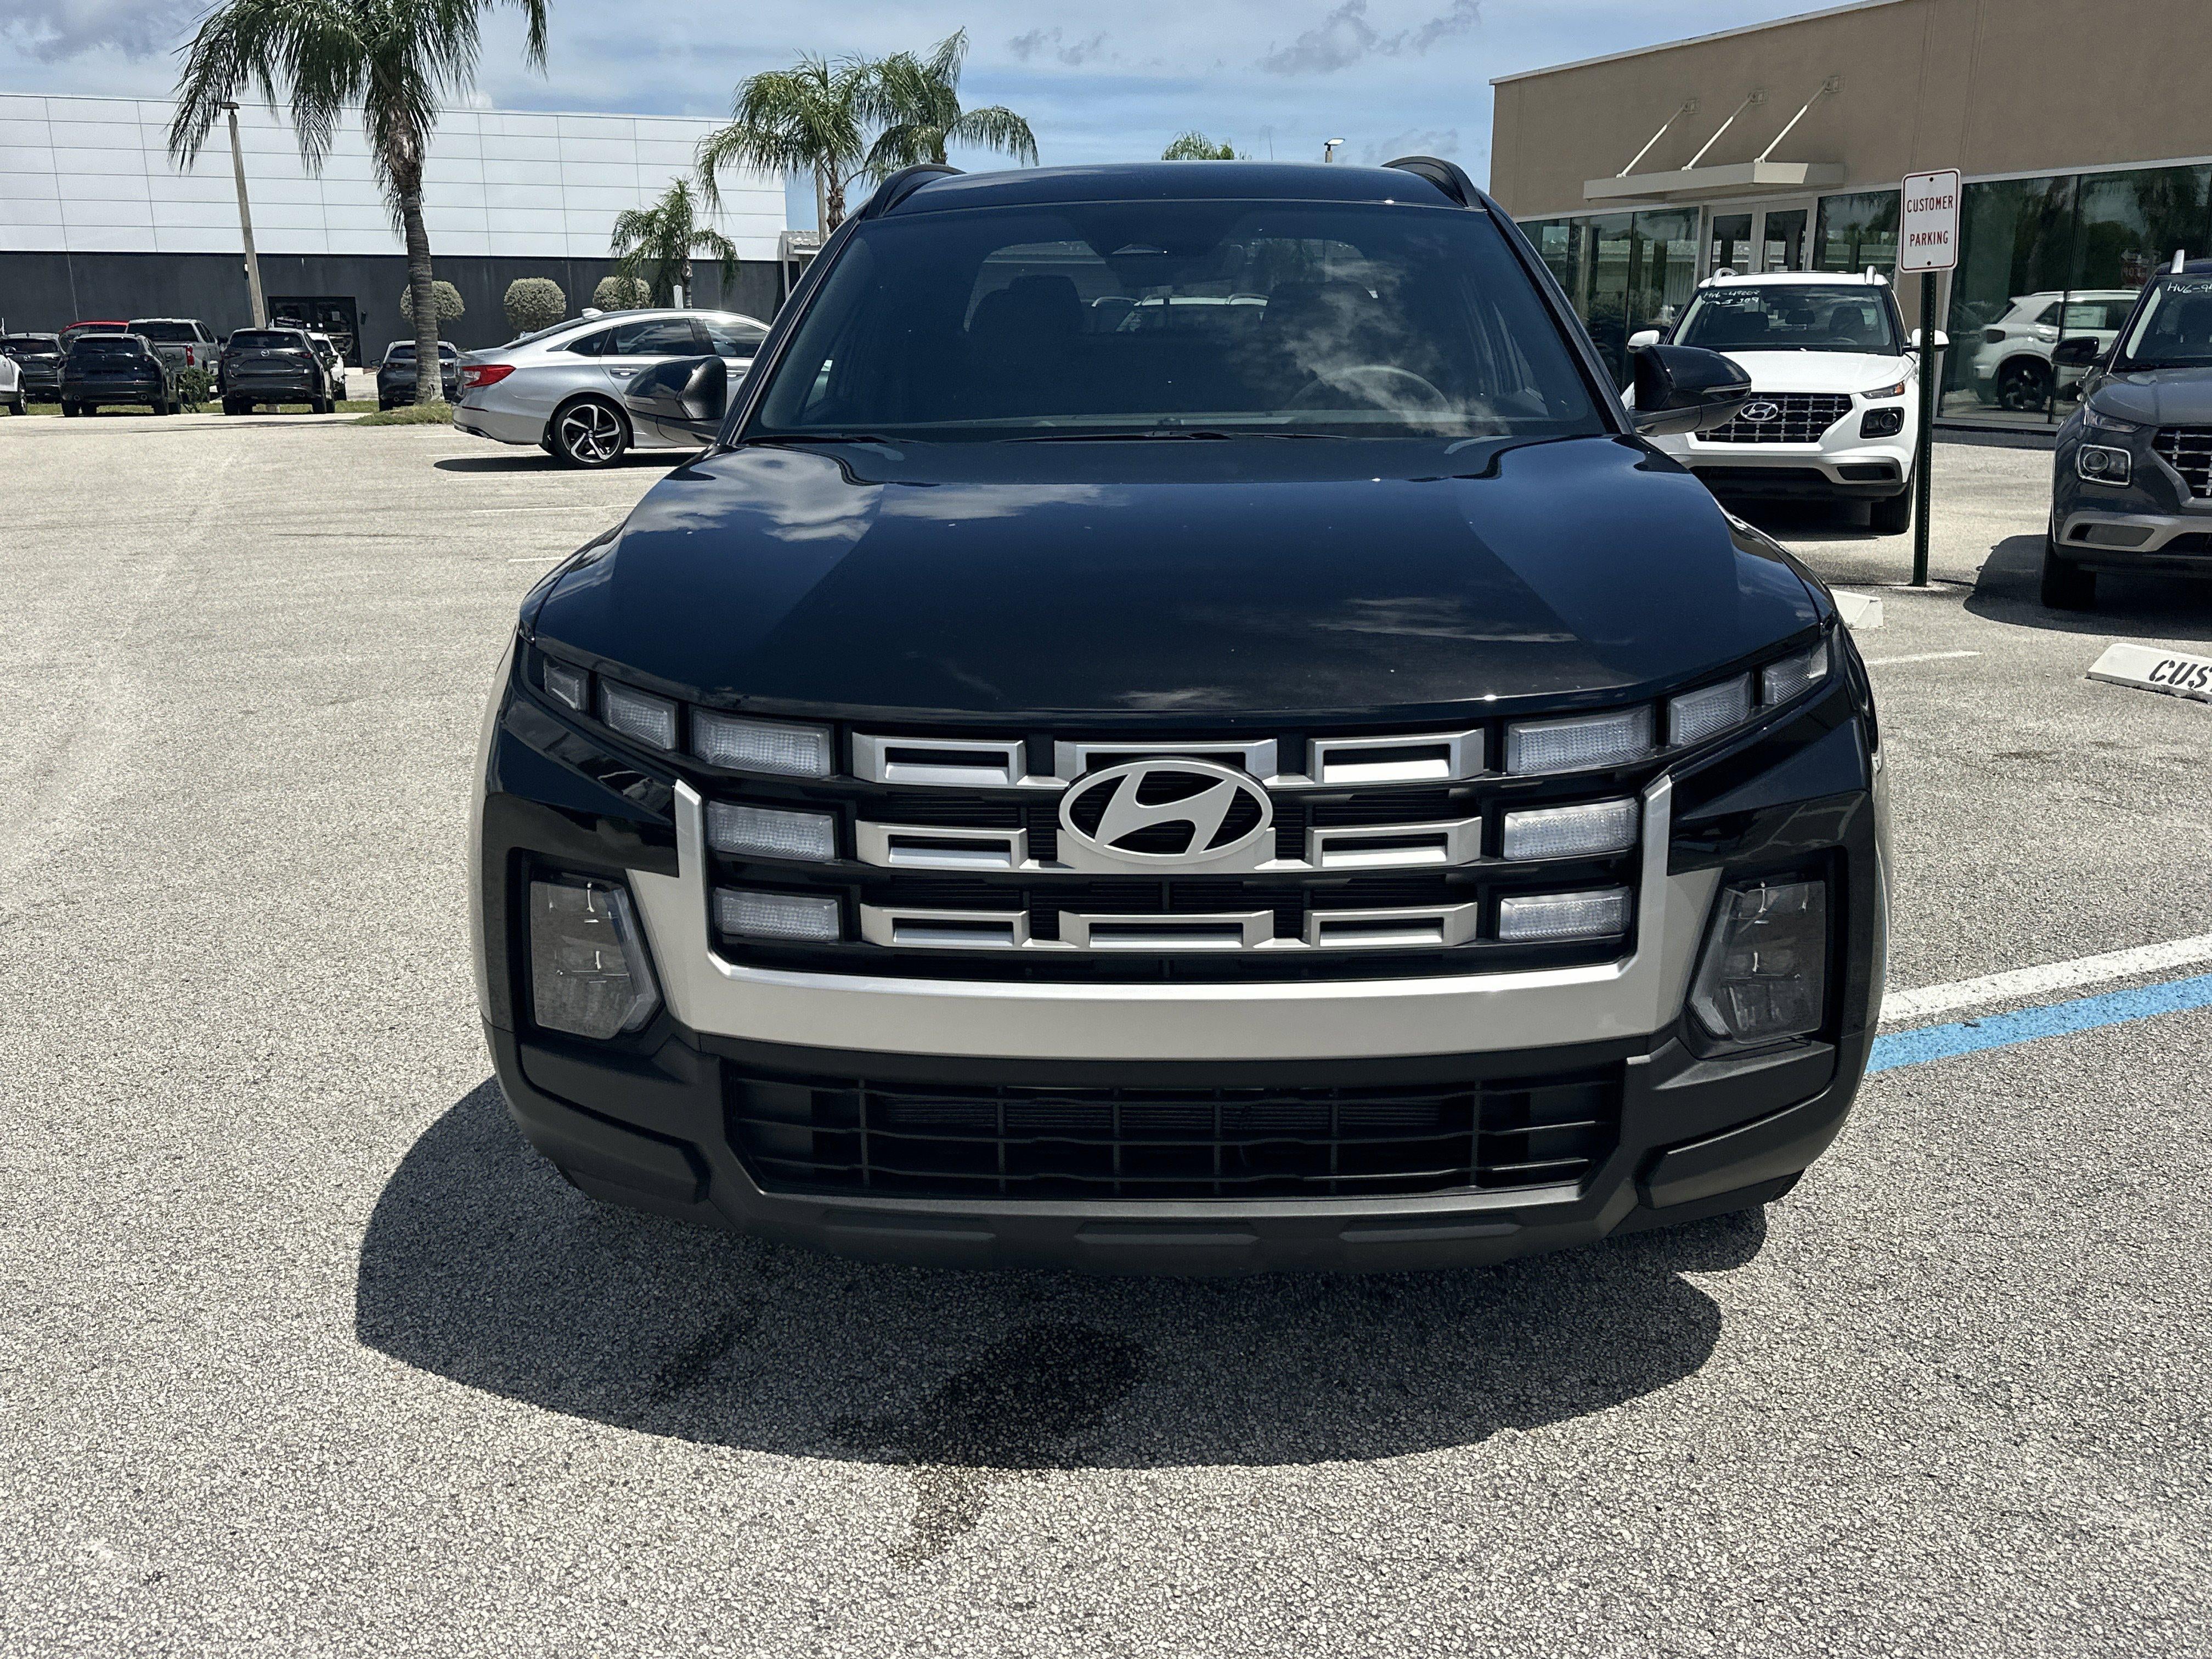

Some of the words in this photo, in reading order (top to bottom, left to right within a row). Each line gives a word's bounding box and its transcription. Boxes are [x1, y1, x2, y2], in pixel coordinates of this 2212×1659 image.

[1906, 195, 1954, 213] CUSTOMER
[1910, 230, 1949, 247] PARKING
[2149, 659, 2212, 692] CUS
